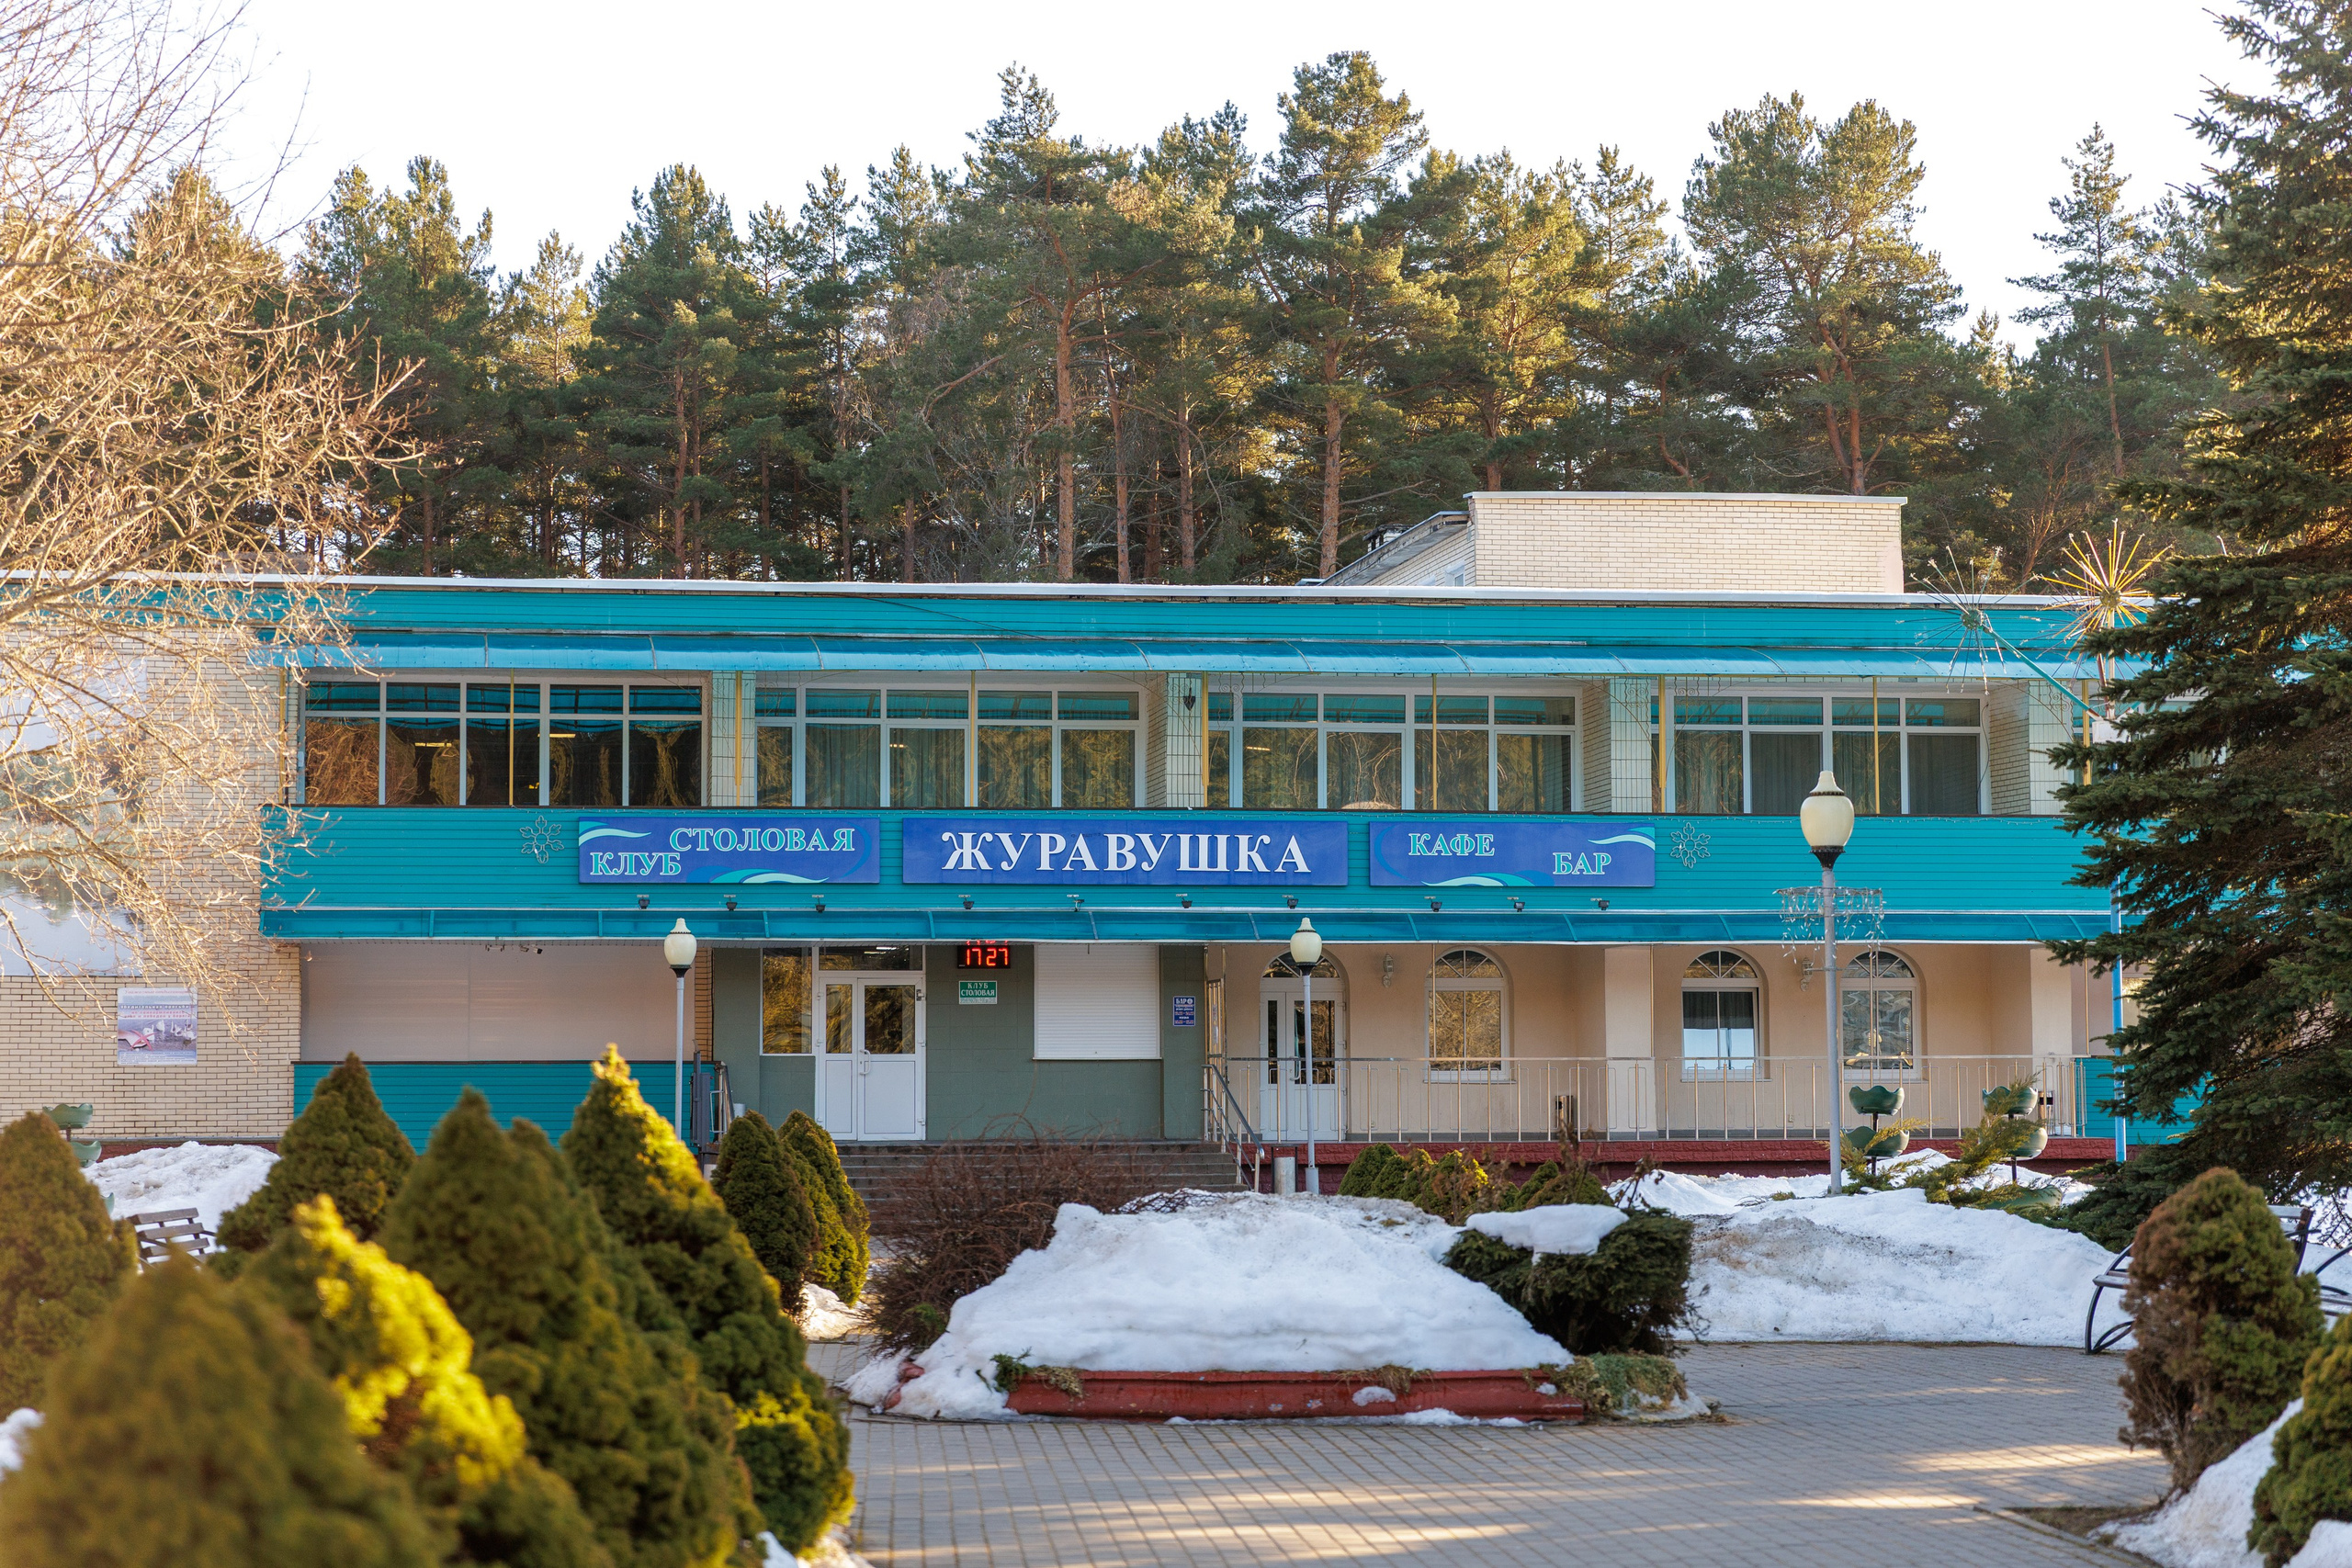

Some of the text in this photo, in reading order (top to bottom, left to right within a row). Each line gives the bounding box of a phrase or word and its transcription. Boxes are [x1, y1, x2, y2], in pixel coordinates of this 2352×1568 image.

[669, 828, 855, 852] СТОЛОВАЯ
[1408, 833, 1496, 856] КАФЕ
[590, 852, 682, 875] КЛУБ
[941, 832, 1312, 873] ЖУРАВУШКА
[1553, 852, 1611, 875] БАР
